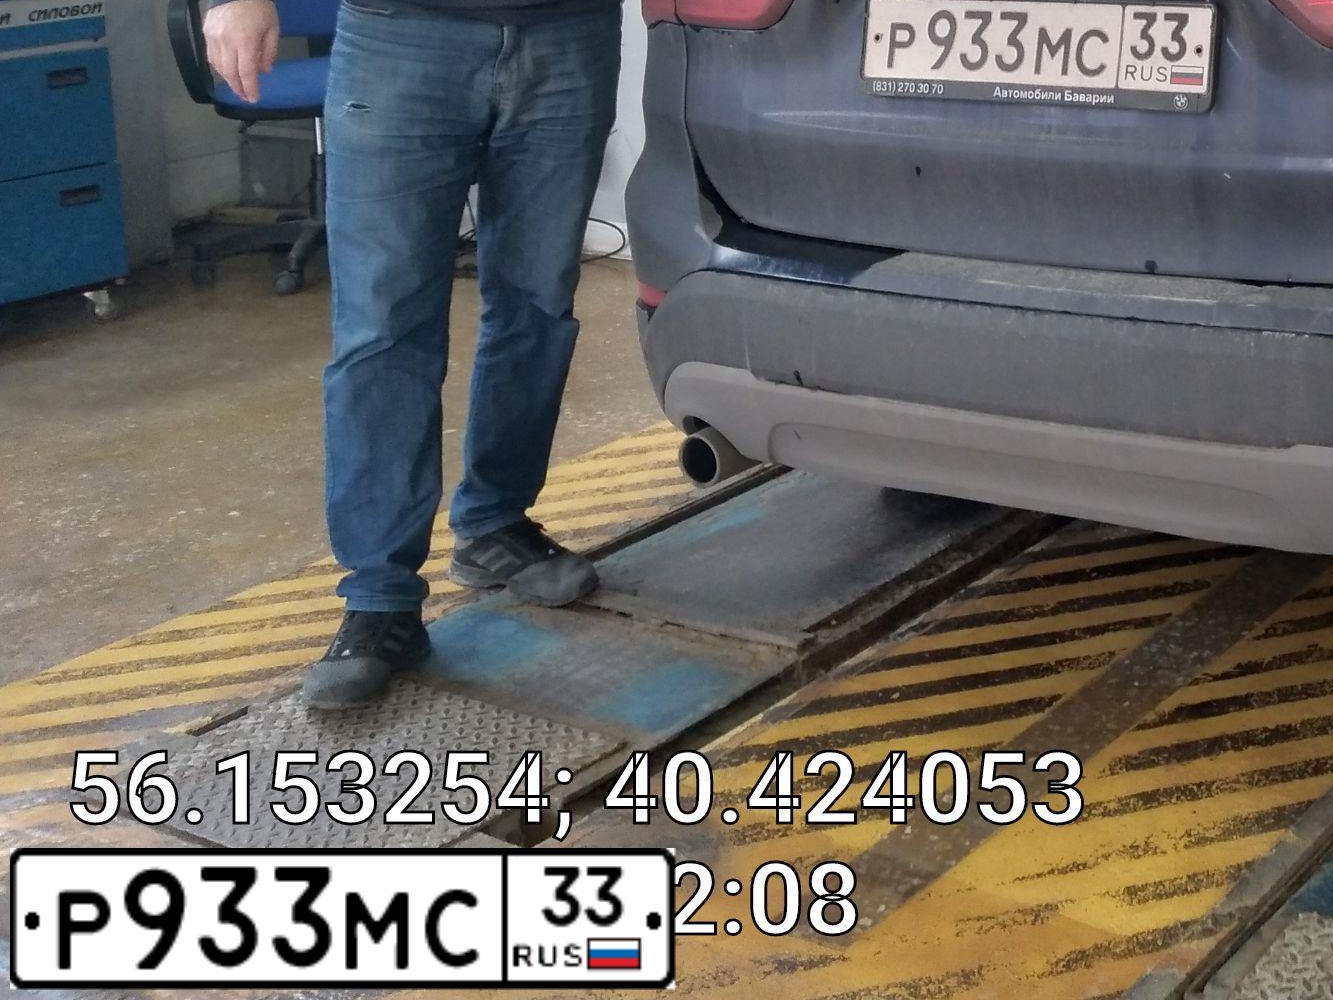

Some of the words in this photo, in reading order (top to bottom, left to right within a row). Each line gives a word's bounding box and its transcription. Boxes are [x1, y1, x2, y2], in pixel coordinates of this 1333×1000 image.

[1129, 11, 1188, 63] 33
[1123, 64, 1169, 83] RUS
[872, 81, 897, 94] (831)
[898, 83, 916, 94] 270
[993, 86, 1062, 102] Автомобили
[1064, 89, 1115, 104] Баварии
